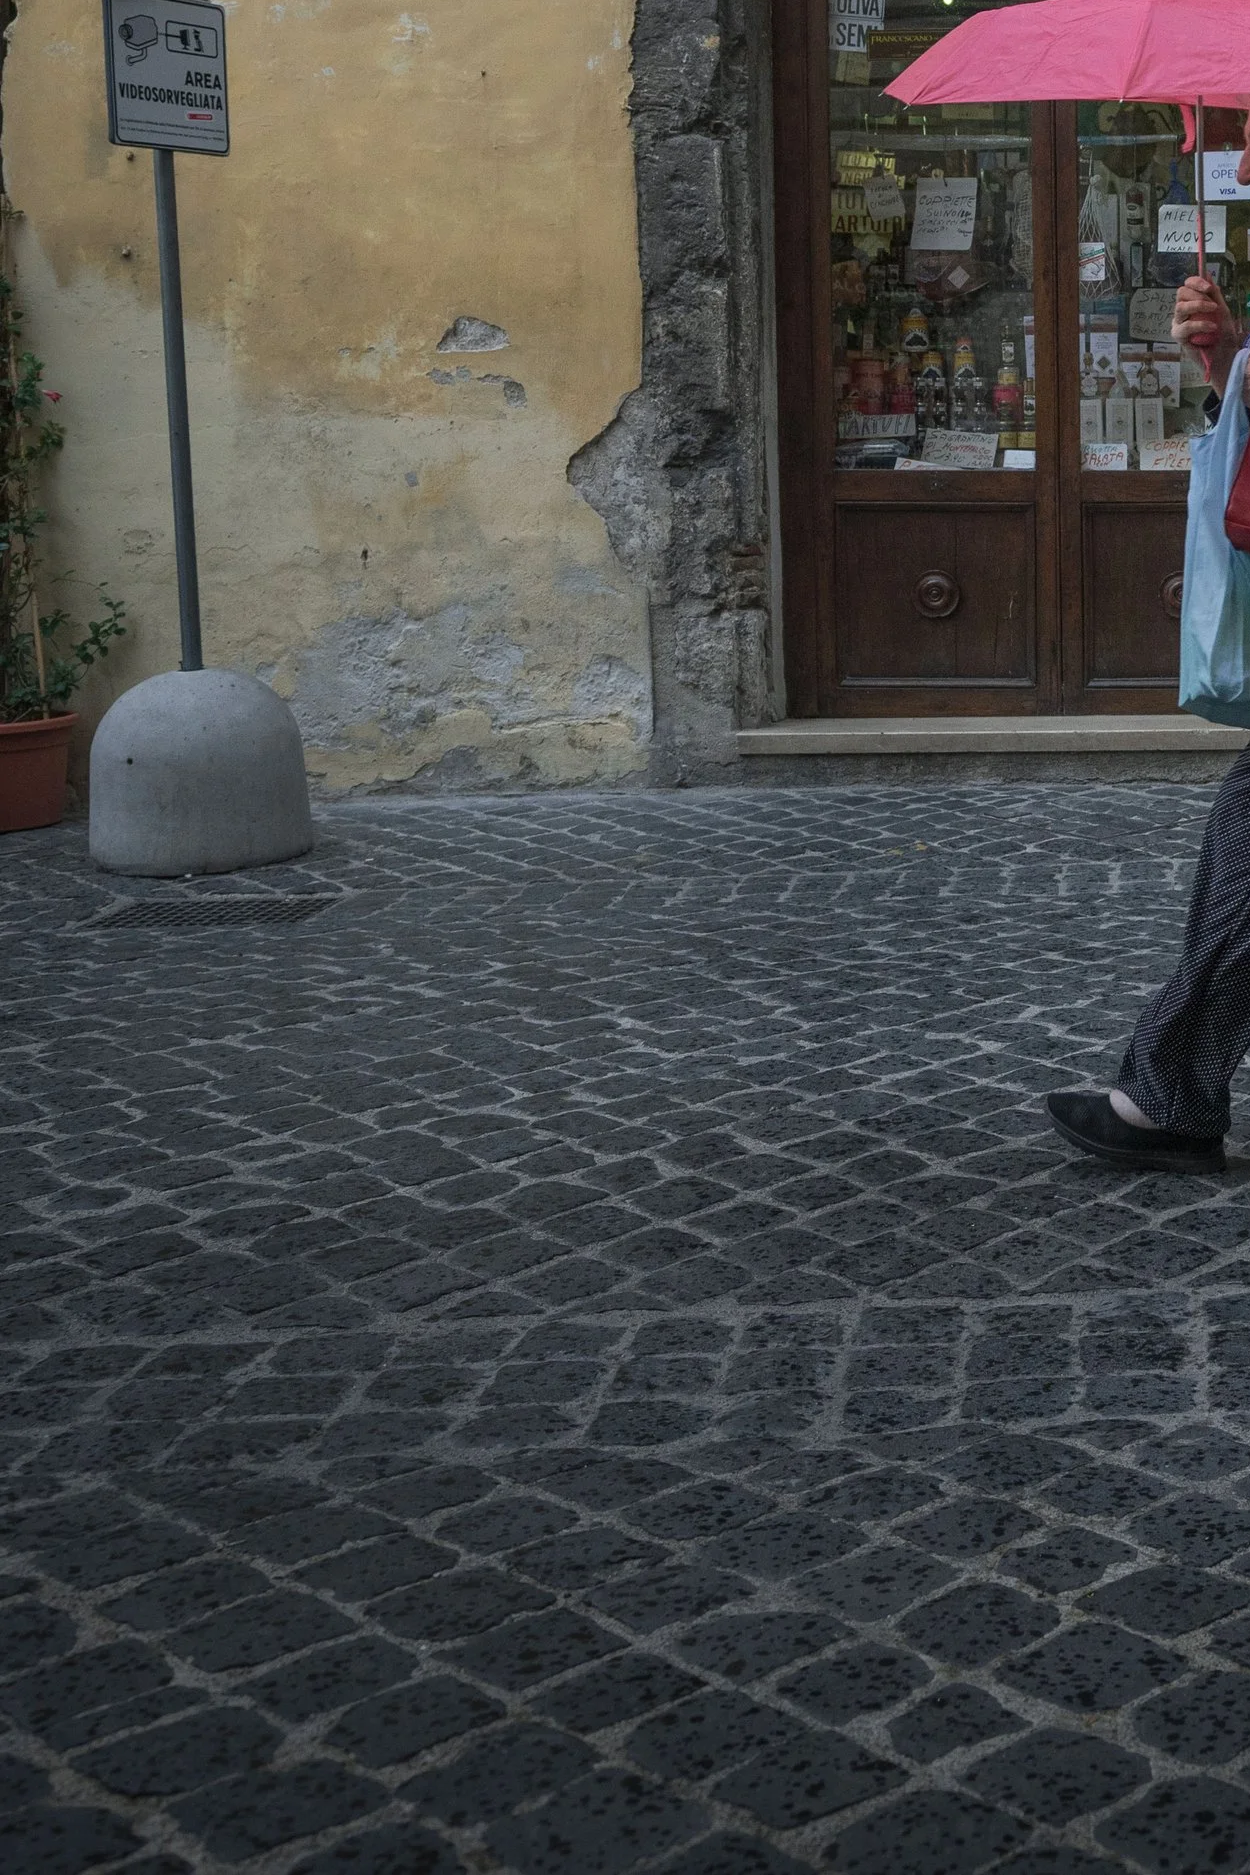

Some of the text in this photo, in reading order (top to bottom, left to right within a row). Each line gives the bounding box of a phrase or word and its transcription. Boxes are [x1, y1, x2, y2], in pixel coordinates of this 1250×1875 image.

[185, 71, 222, 90] AREA
[119, 82, 223, 111] VIDEOSORVEGLIATA
[1137, 289, 1176, 303] SALS
[1145, 440, 1189, 452] COPPIE
